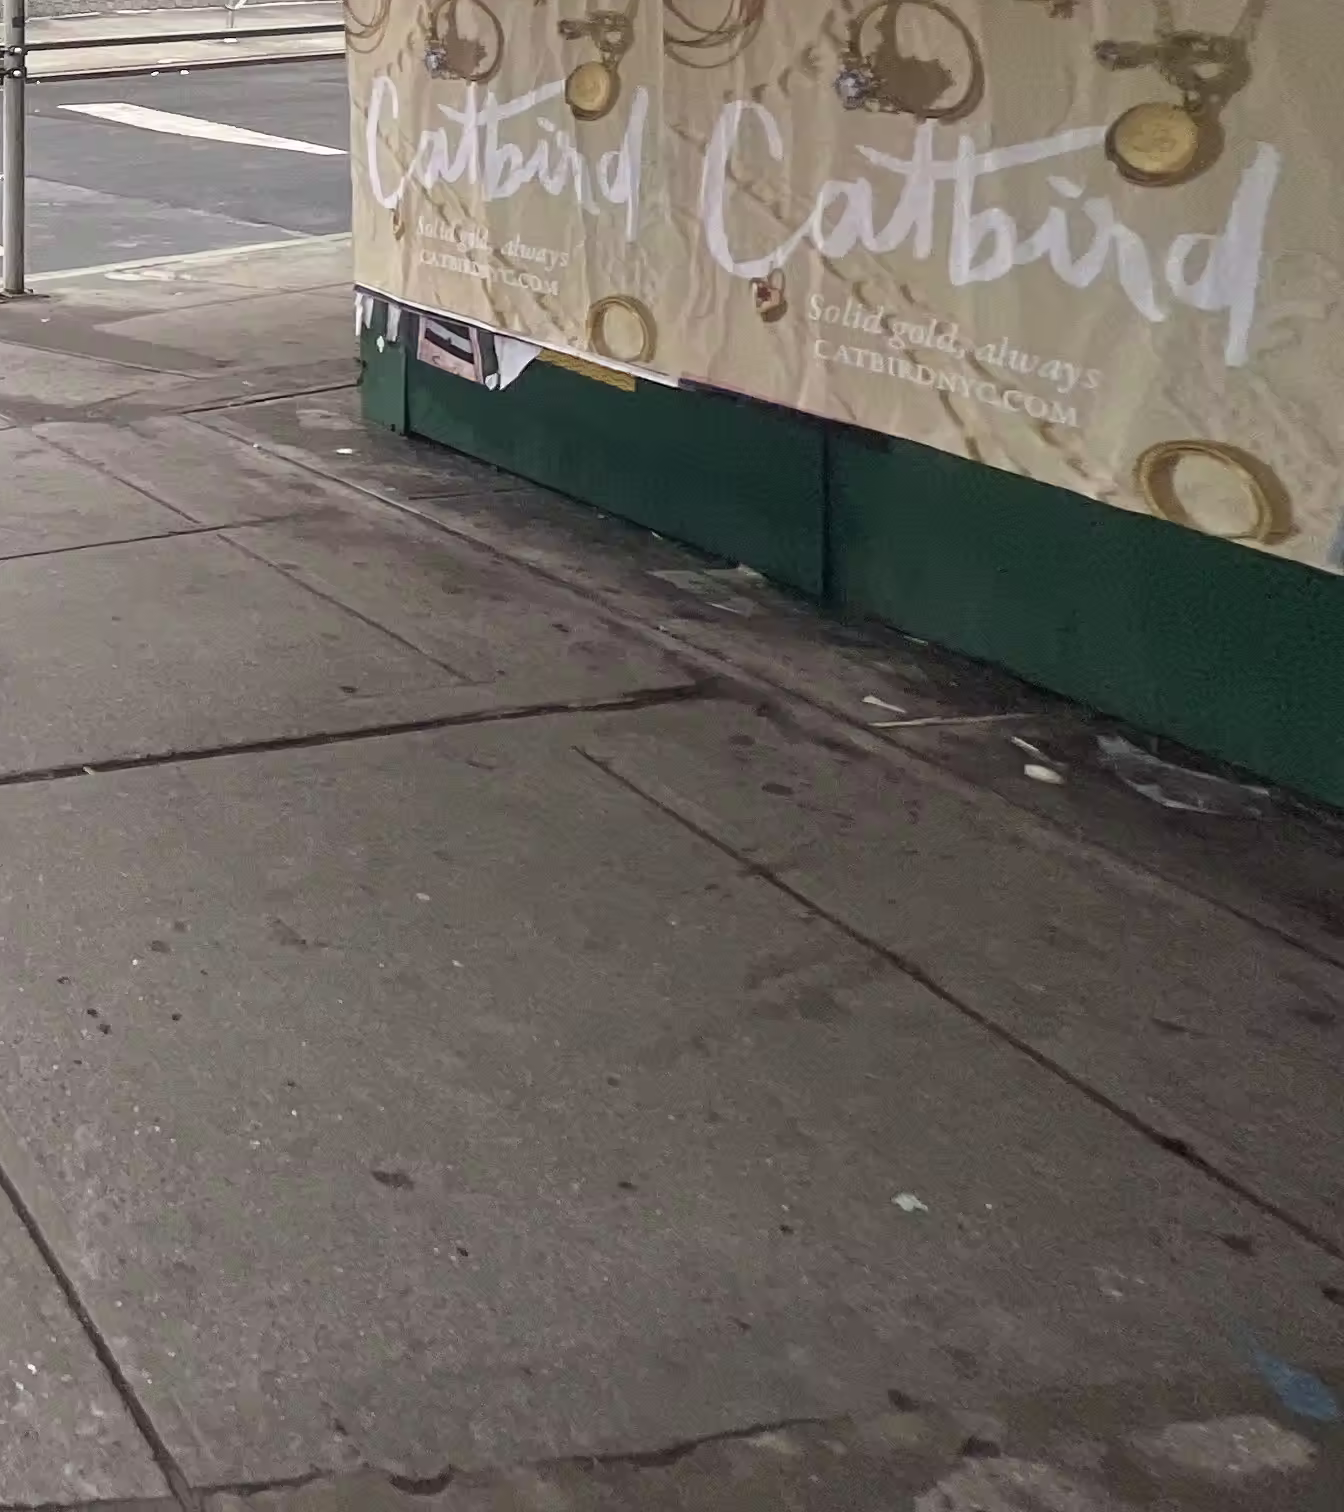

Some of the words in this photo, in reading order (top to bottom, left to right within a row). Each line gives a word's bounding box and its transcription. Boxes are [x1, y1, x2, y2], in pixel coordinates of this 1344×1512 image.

[366, 76, 649, 241] Catbird
[501, 233, 570, 273] always
[702, 98, 1283, 368] Catbird
[809, 293, 885, 336] Solid
[887, 316, 969, 361] gold,
[977, 338, 1103, 393] always
[814, 337, 1080, 428] CATBIRDNYC.COM
